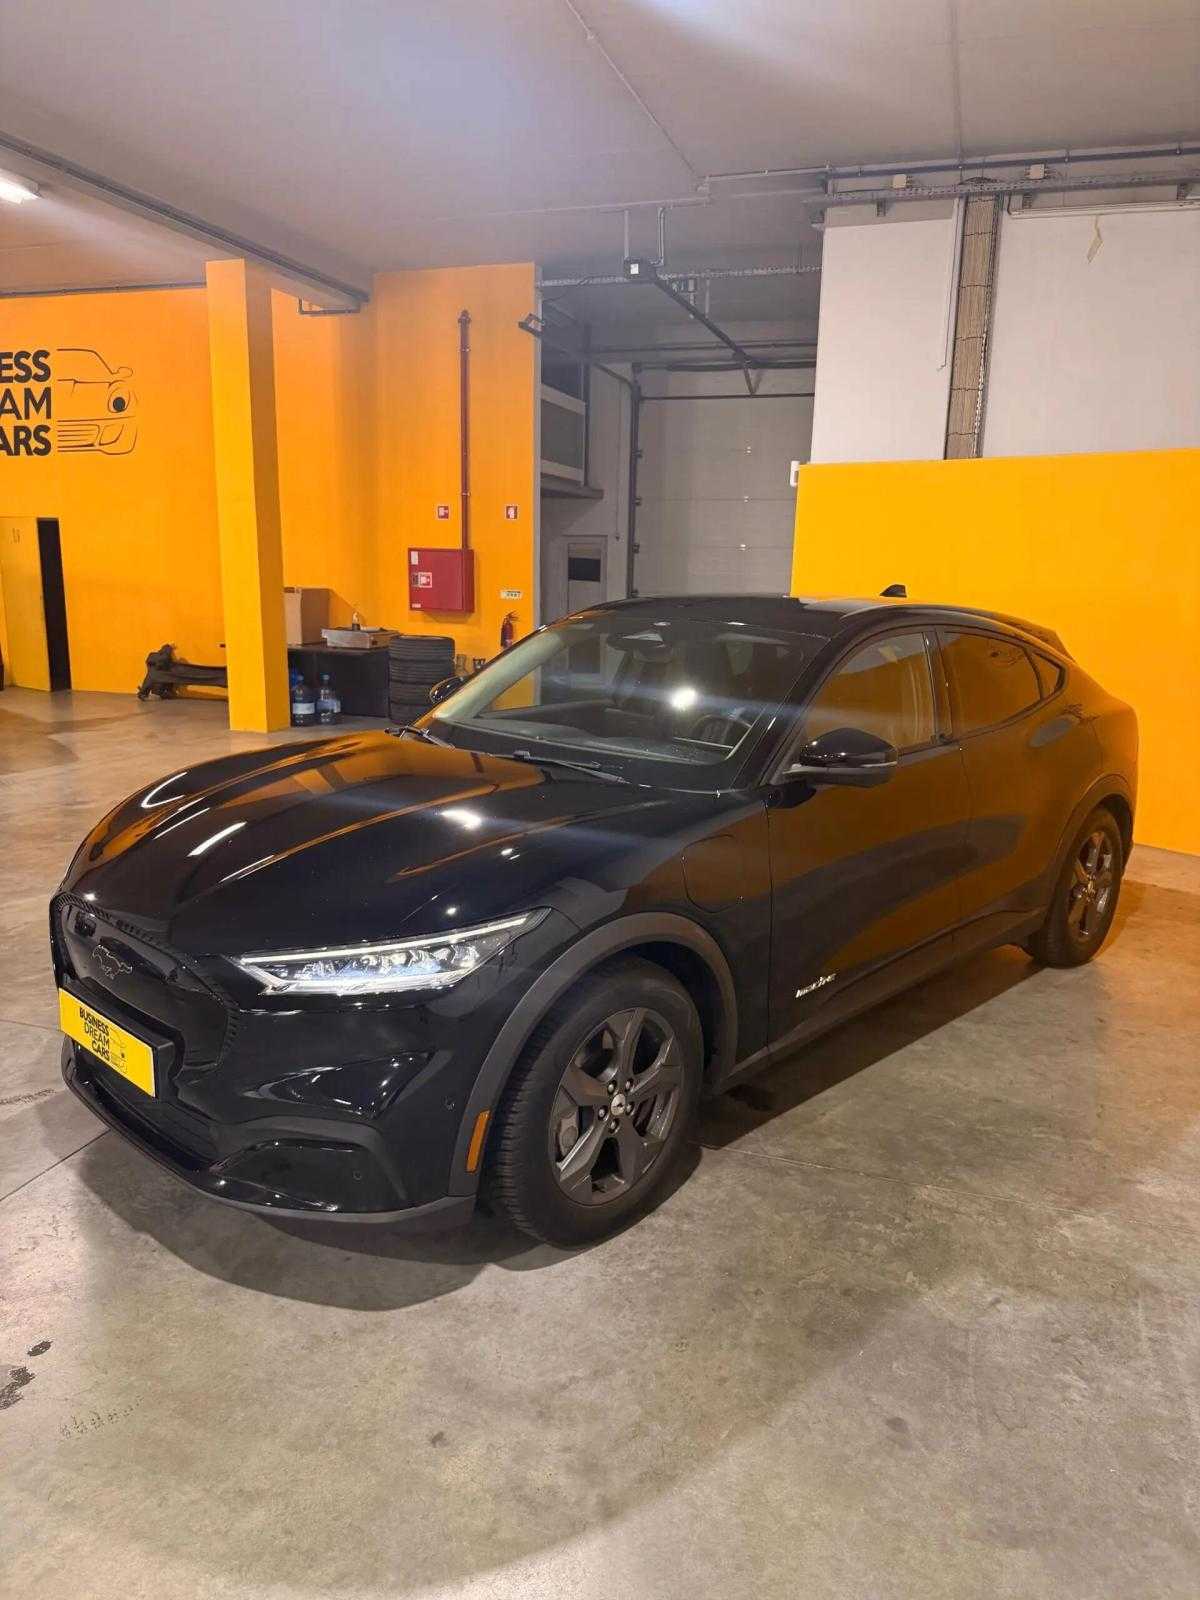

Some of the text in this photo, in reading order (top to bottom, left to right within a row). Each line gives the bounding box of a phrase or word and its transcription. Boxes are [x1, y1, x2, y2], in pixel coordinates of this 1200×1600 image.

[0, 350, 51, 383] ESS
[0, 387, 52, 420] AM
[79, 1006, 110, 1037] BUSINESS
[84, 1021, 110, 1050] DREAM
[91, 1040, 110, 1062] CARS
